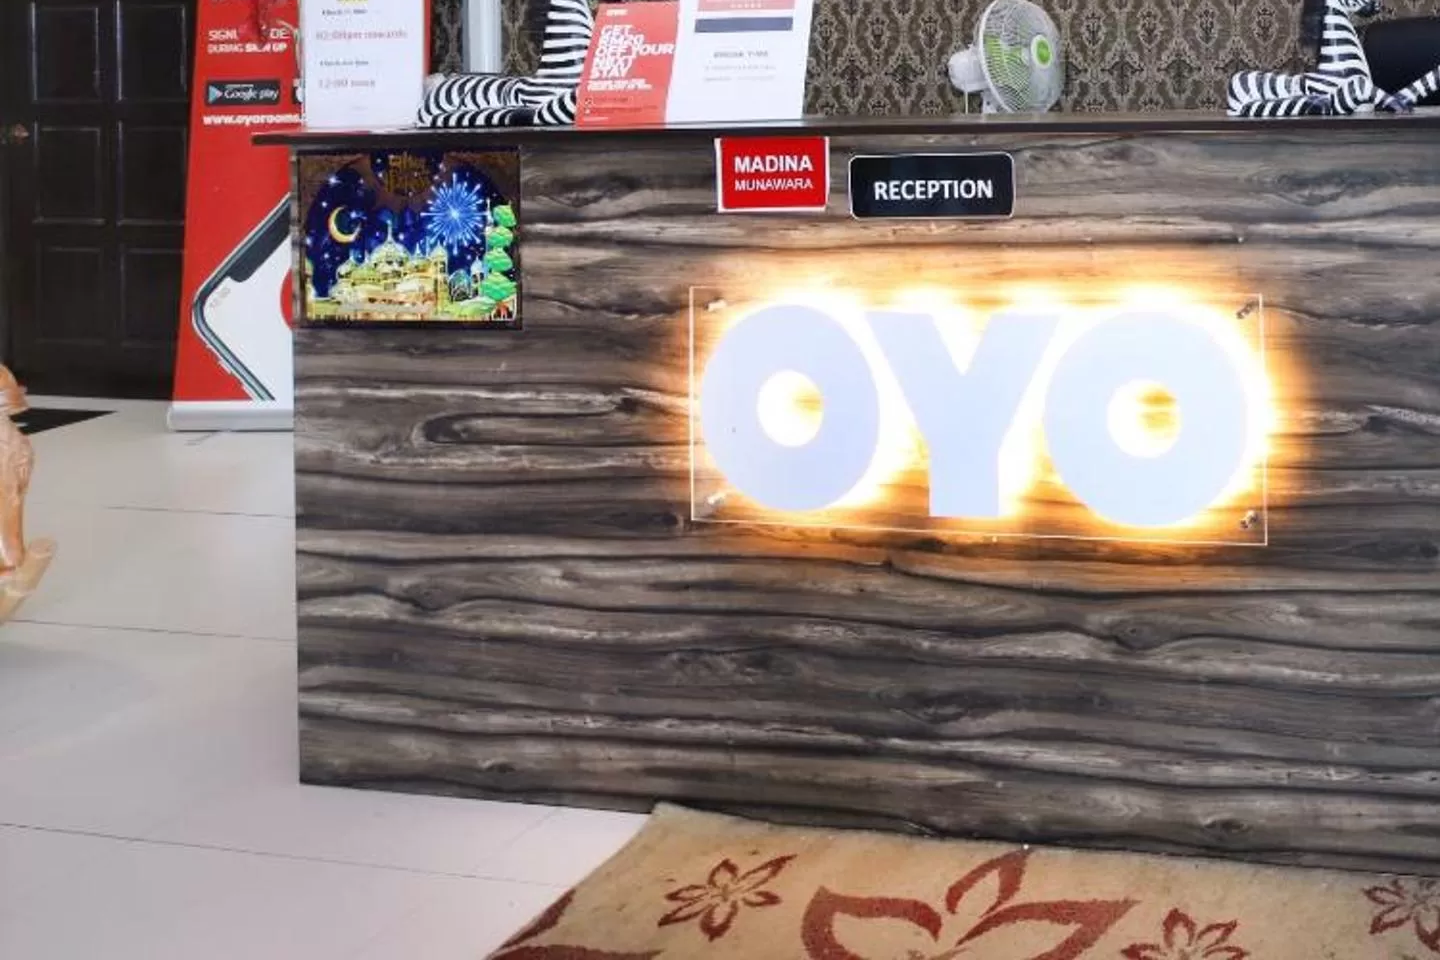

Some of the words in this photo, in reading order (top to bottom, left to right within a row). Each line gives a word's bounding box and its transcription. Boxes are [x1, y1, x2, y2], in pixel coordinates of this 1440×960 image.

[629, 43, 675, 59] YOUR
[224, 88, 257, 102] Google
[734, 154, 813, 173] MADINA
[734, 177, 814, 191] MUNAWARA
[873, 179, 994, 201] RECEPTION
[700, 303, 1249, 527] OYO
